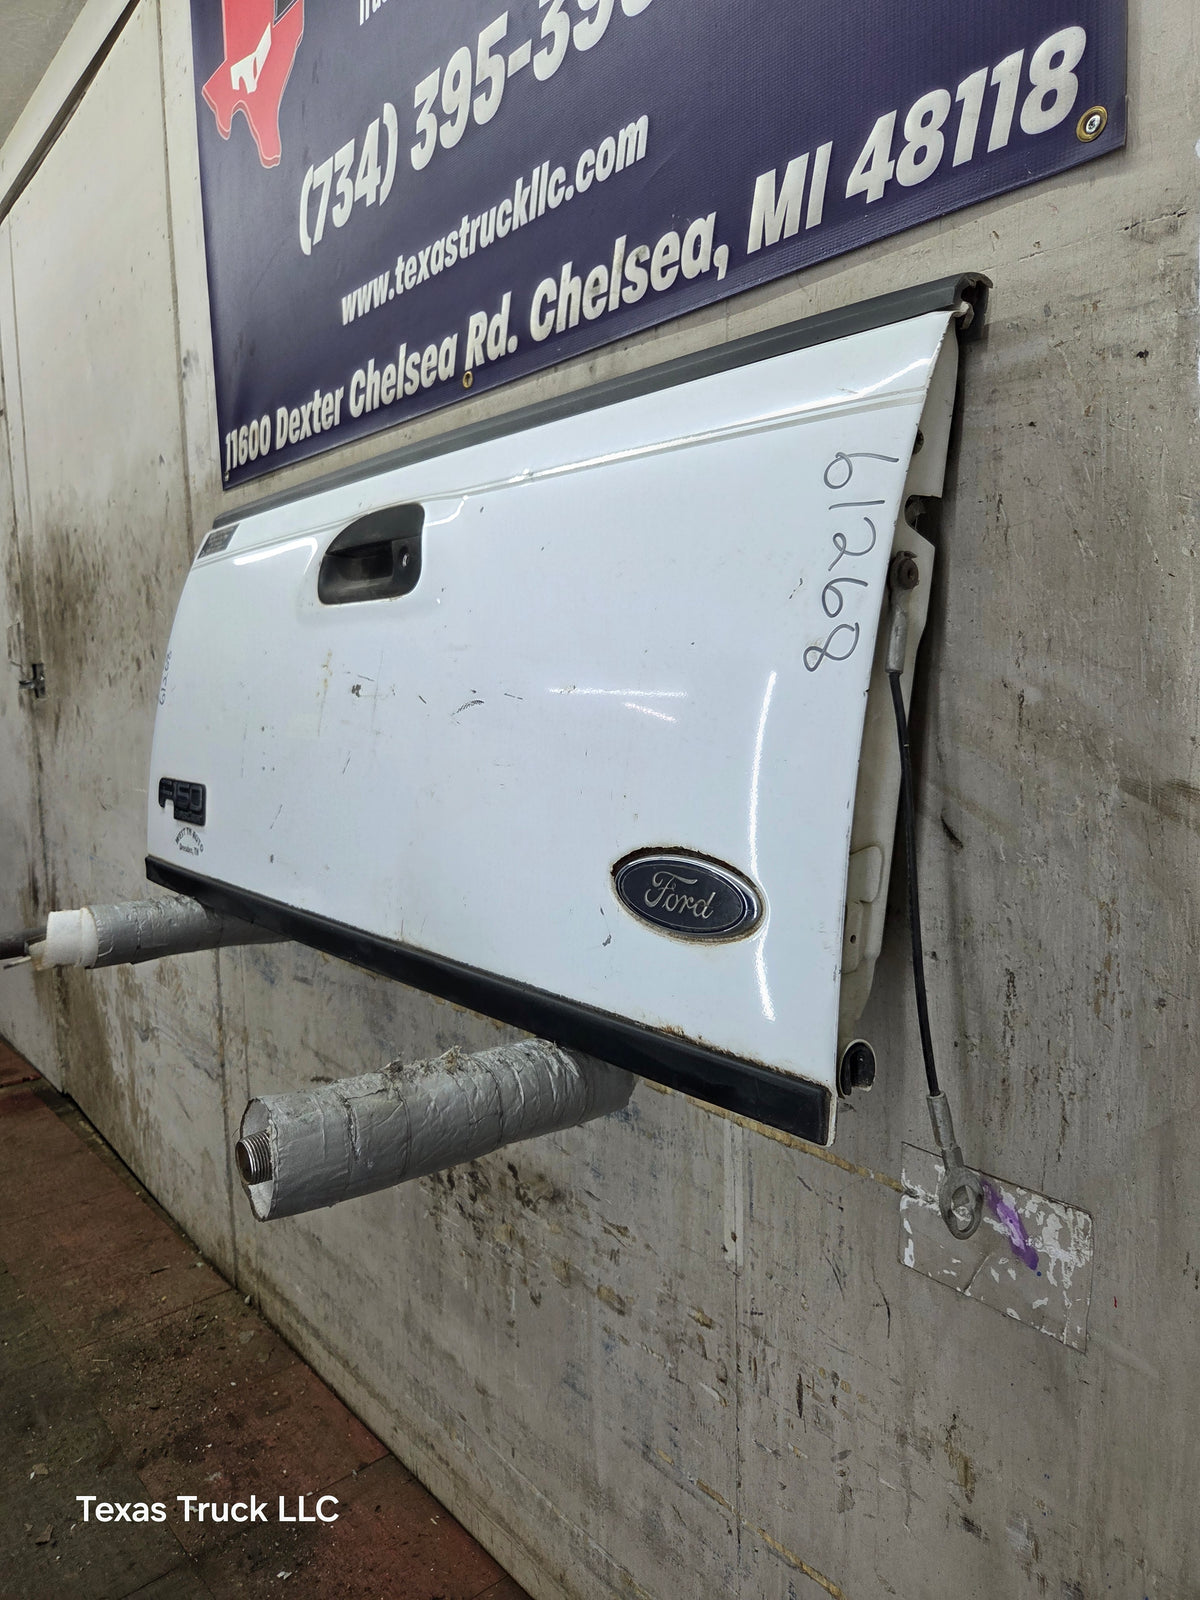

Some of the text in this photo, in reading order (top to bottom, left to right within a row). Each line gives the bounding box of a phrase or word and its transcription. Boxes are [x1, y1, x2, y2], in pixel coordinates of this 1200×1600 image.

[299, 0, 653, 256] (734) 395-39
[341, 115, 649, 326] www.texastruckllc.com
[225, 26, 1087, 471] 11600 Dexter Chelsea Rd. Chelsea, MI 48118
[803, 451, 900, 673] 61268
[644, 870, 717, 920] Ford
